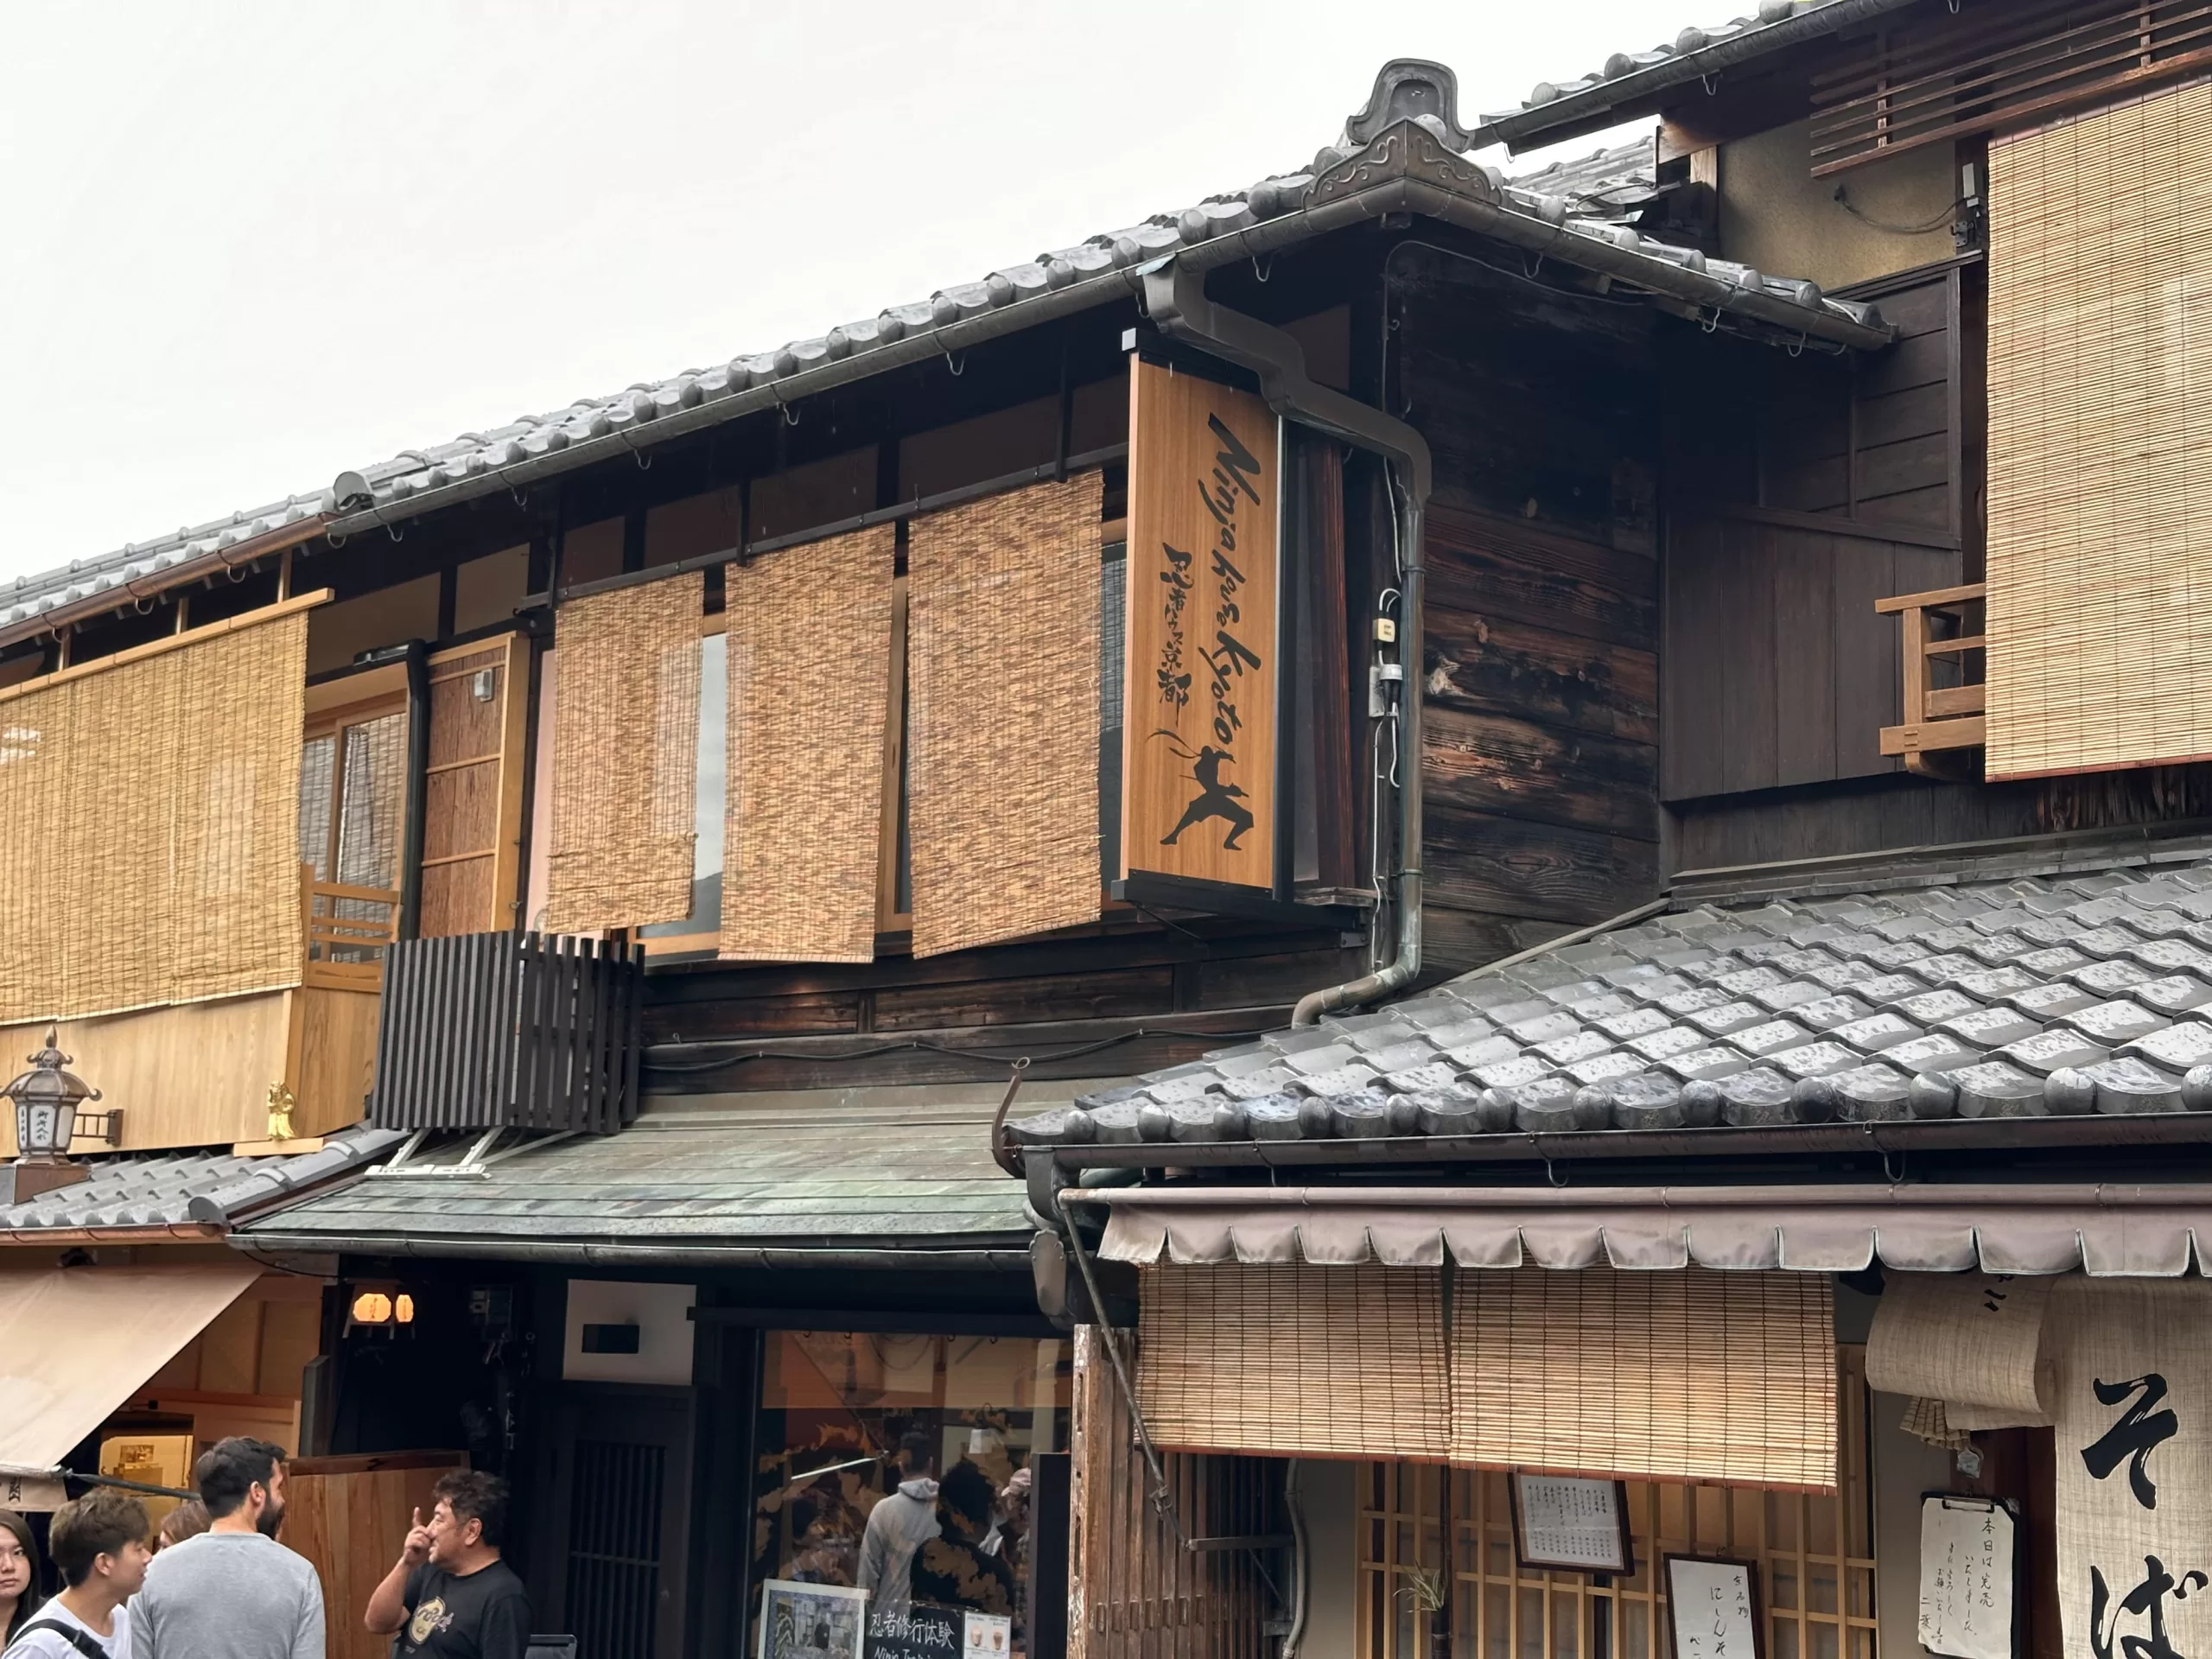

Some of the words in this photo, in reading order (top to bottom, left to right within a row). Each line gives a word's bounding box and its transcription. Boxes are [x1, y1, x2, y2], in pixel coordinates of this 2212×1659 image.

[1198, 411, 1262, 551] Ninja
[1155, 542, 1195, 727] 忍者ハウス京都
[1211, 548, 1247, 627] house
[1198, 629, 1262, 745] Kyoto
[1979, 1517, 1995, 1608] 本日は完売
[2080, 1373, 2209, 1659] そば
[868, 1610, 956, 1649] 忍者修行体験
